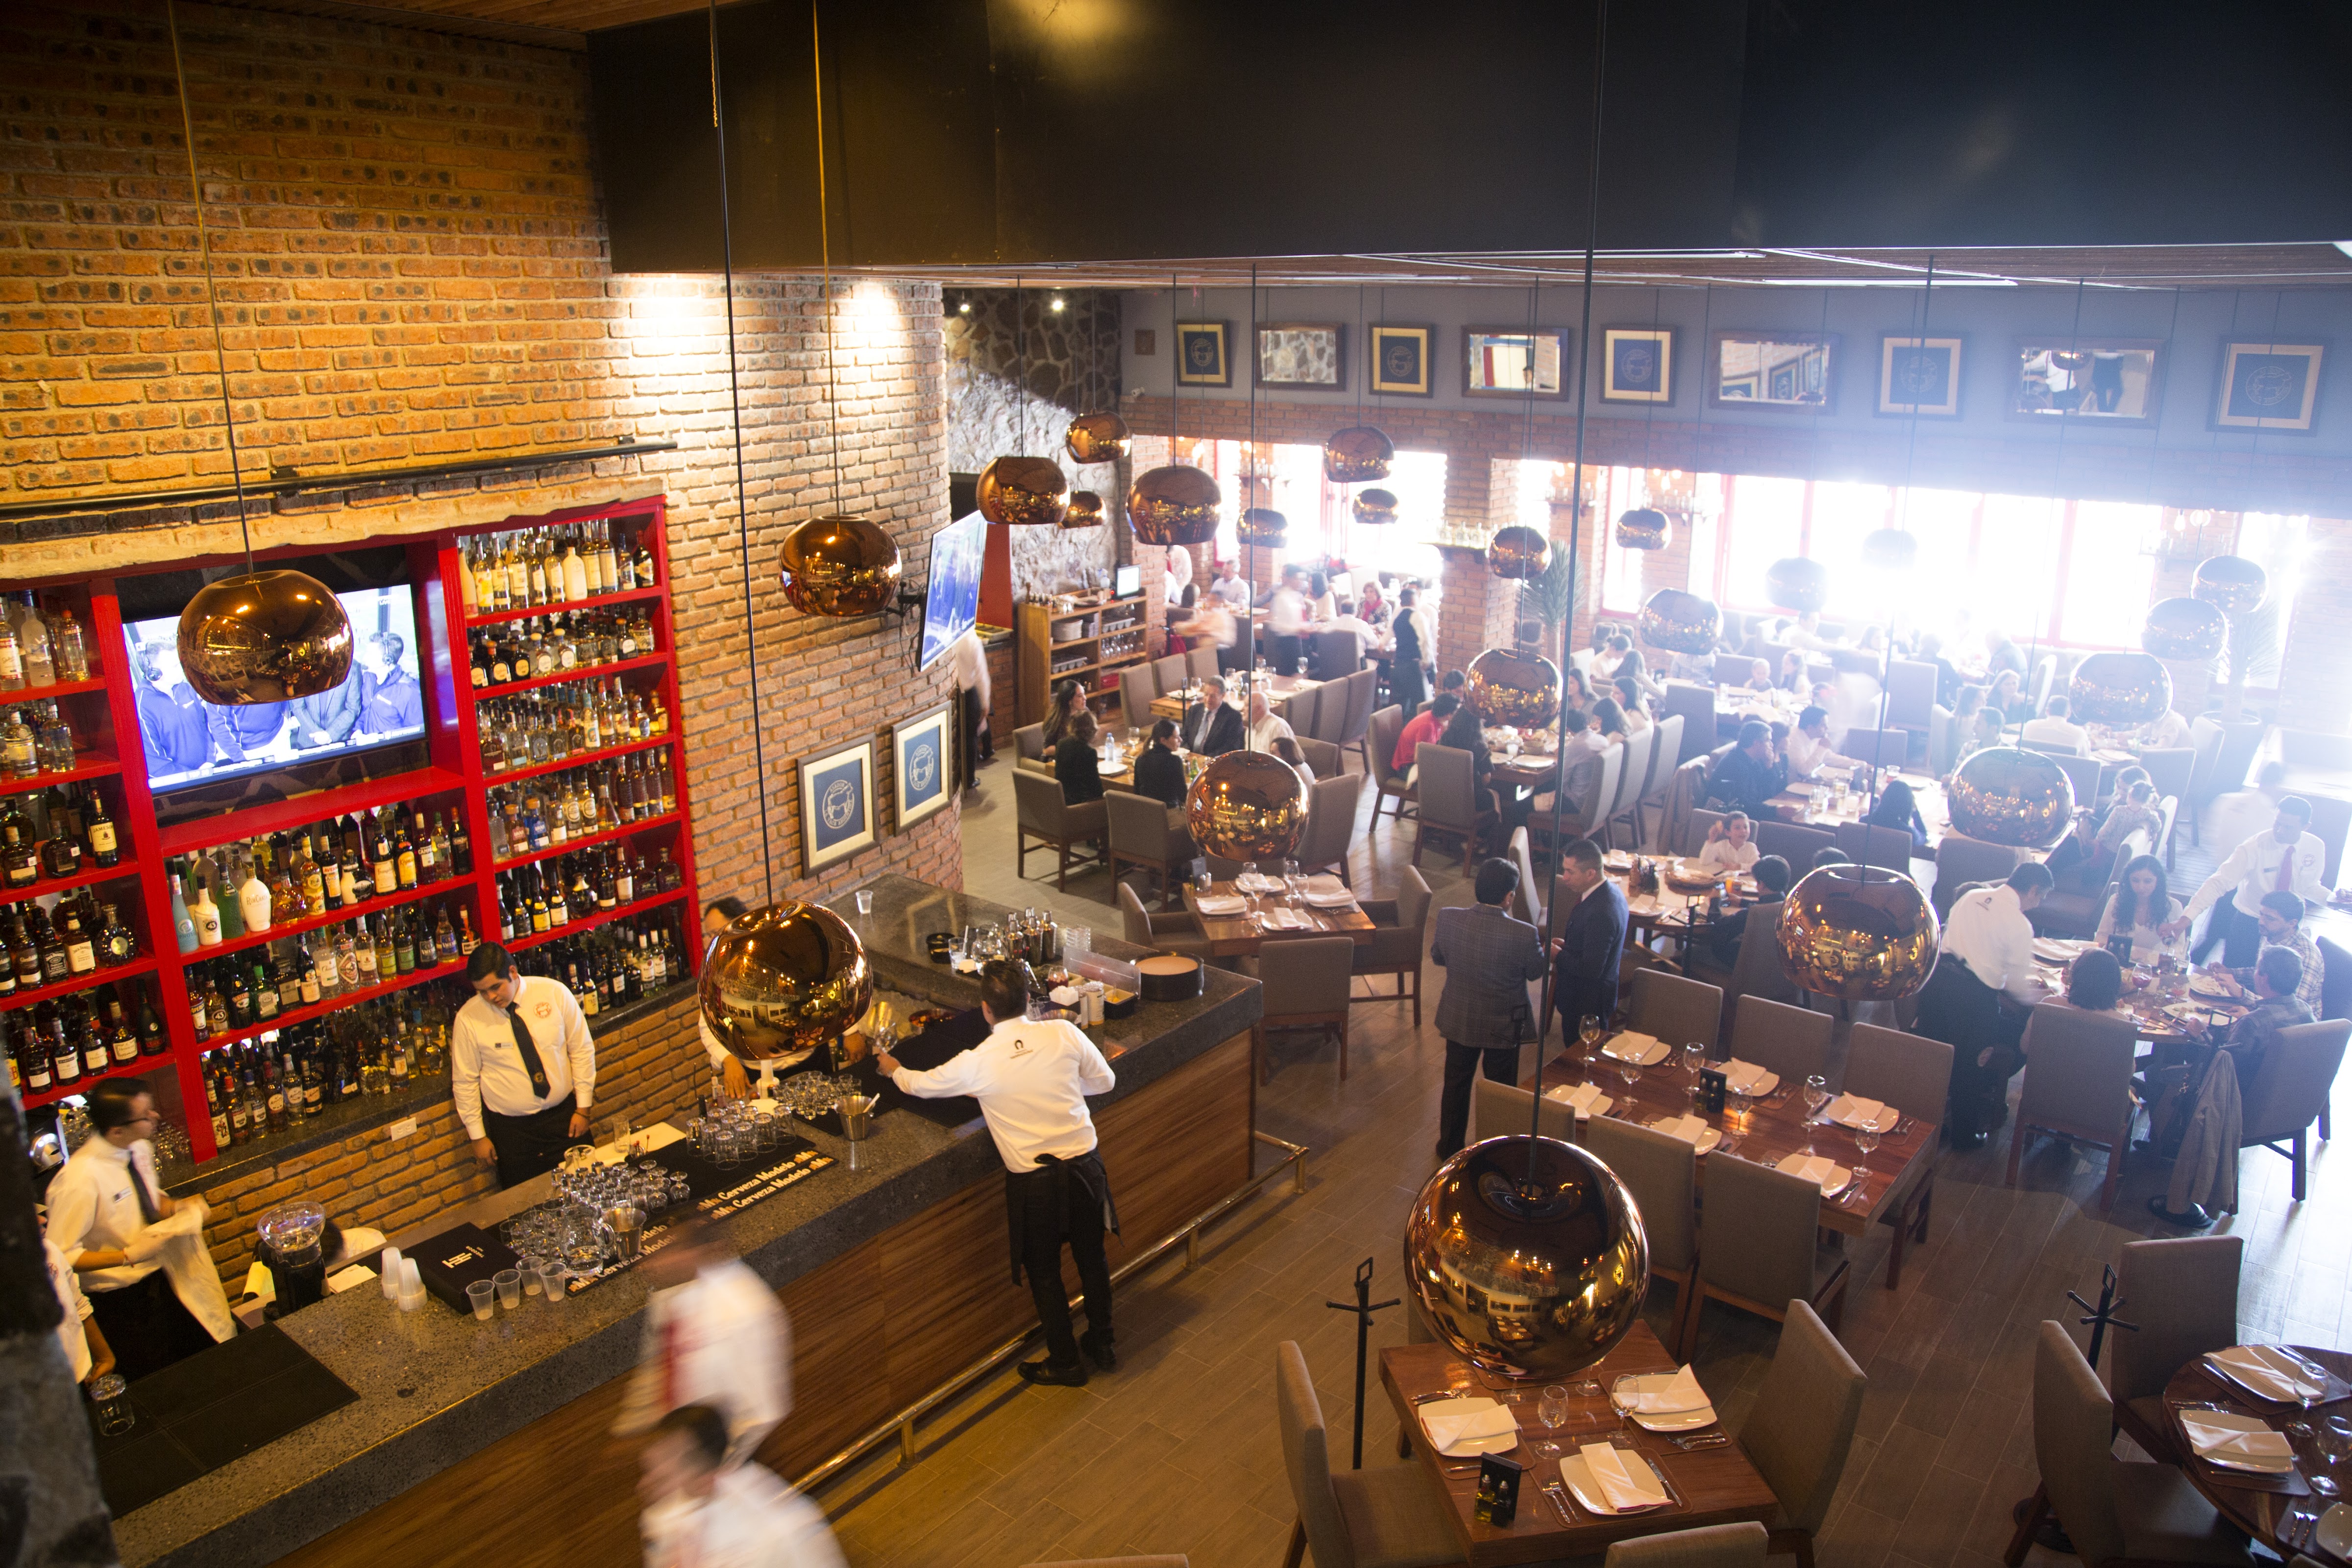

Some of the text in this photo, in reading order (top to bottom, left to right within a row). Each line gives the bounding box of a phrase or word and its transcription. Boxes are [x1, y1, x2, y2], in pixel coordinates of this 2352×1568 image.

[718, 1179, 761, 1200] Cerveza
[755, 1161, 796, 1181] Modelo
[732, 1186, 777, 1208] Cerveza
[770, 1168, 811, 1188] Modelo
[639, 1234, 678, 1256] Model
